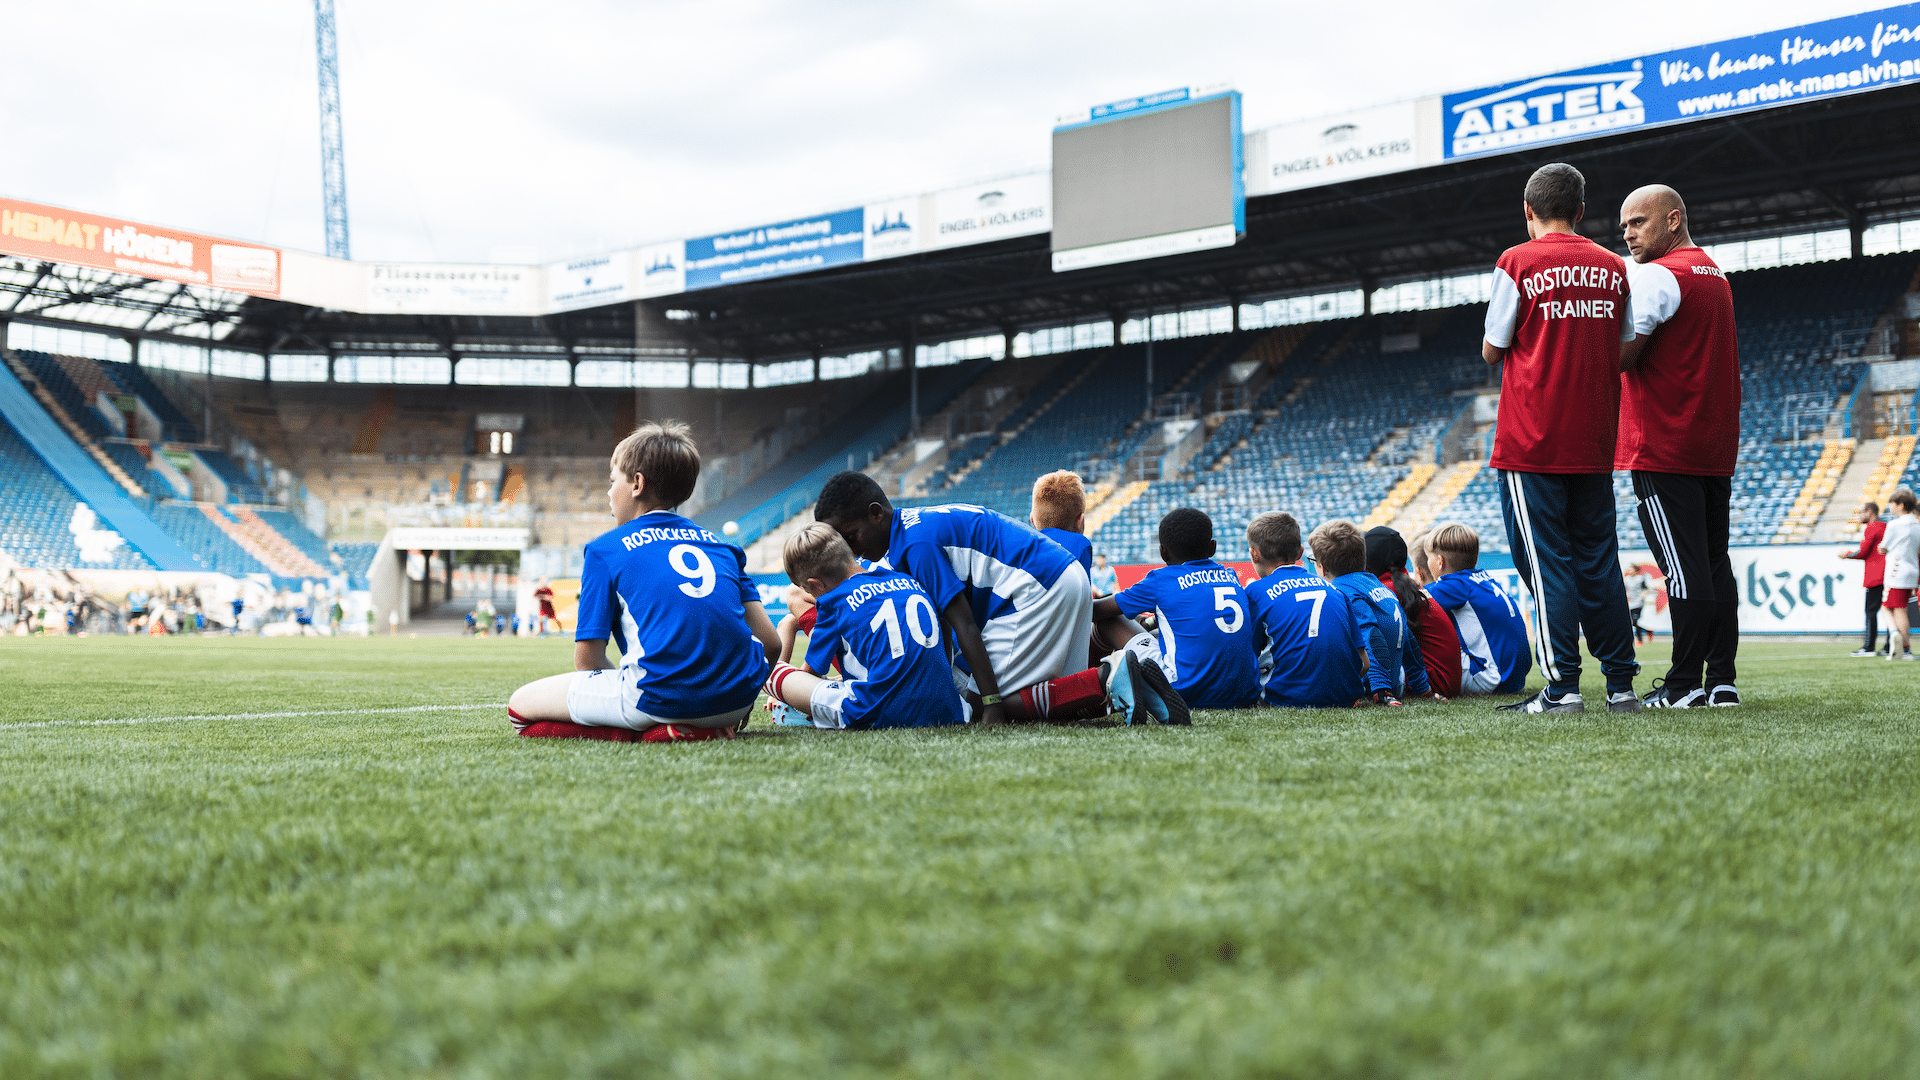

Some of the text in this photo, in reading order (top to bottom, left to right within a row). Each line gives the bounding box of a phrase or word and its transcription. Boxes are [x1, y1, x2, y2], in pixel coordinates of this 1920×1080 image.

[1659, 60, 1705, 87] Wir
[1707, 51, 1775, 81] bauen
[1780, 36, 1866, 66] Häuser
[1453, 80, 1644, 139] ARTEK
[1272, 139, 1412, 177] ENGEL & VÖLKERS
[2, 209, 100, 251] HEIMAT
[103, 225, 194, 268] HÖREN
[1522, 266, 1608, 300] ROSTOCKER
[1539, 300, 1615, 321] TRAINER
[621, 528, 718, 552] ROSTOCKER FC
[668, 544, 716, 598] 9
[846, 578, 913, 612] ROSTOCKER
[1266, 577, 1325, 601] ROSTOCKER
[1746, 558, 1845, 621] bzer
[869, 594, 939, 660] 10
[1213, 586, 1244, 634] 5
[1295, 589, 1327, 638] 7
